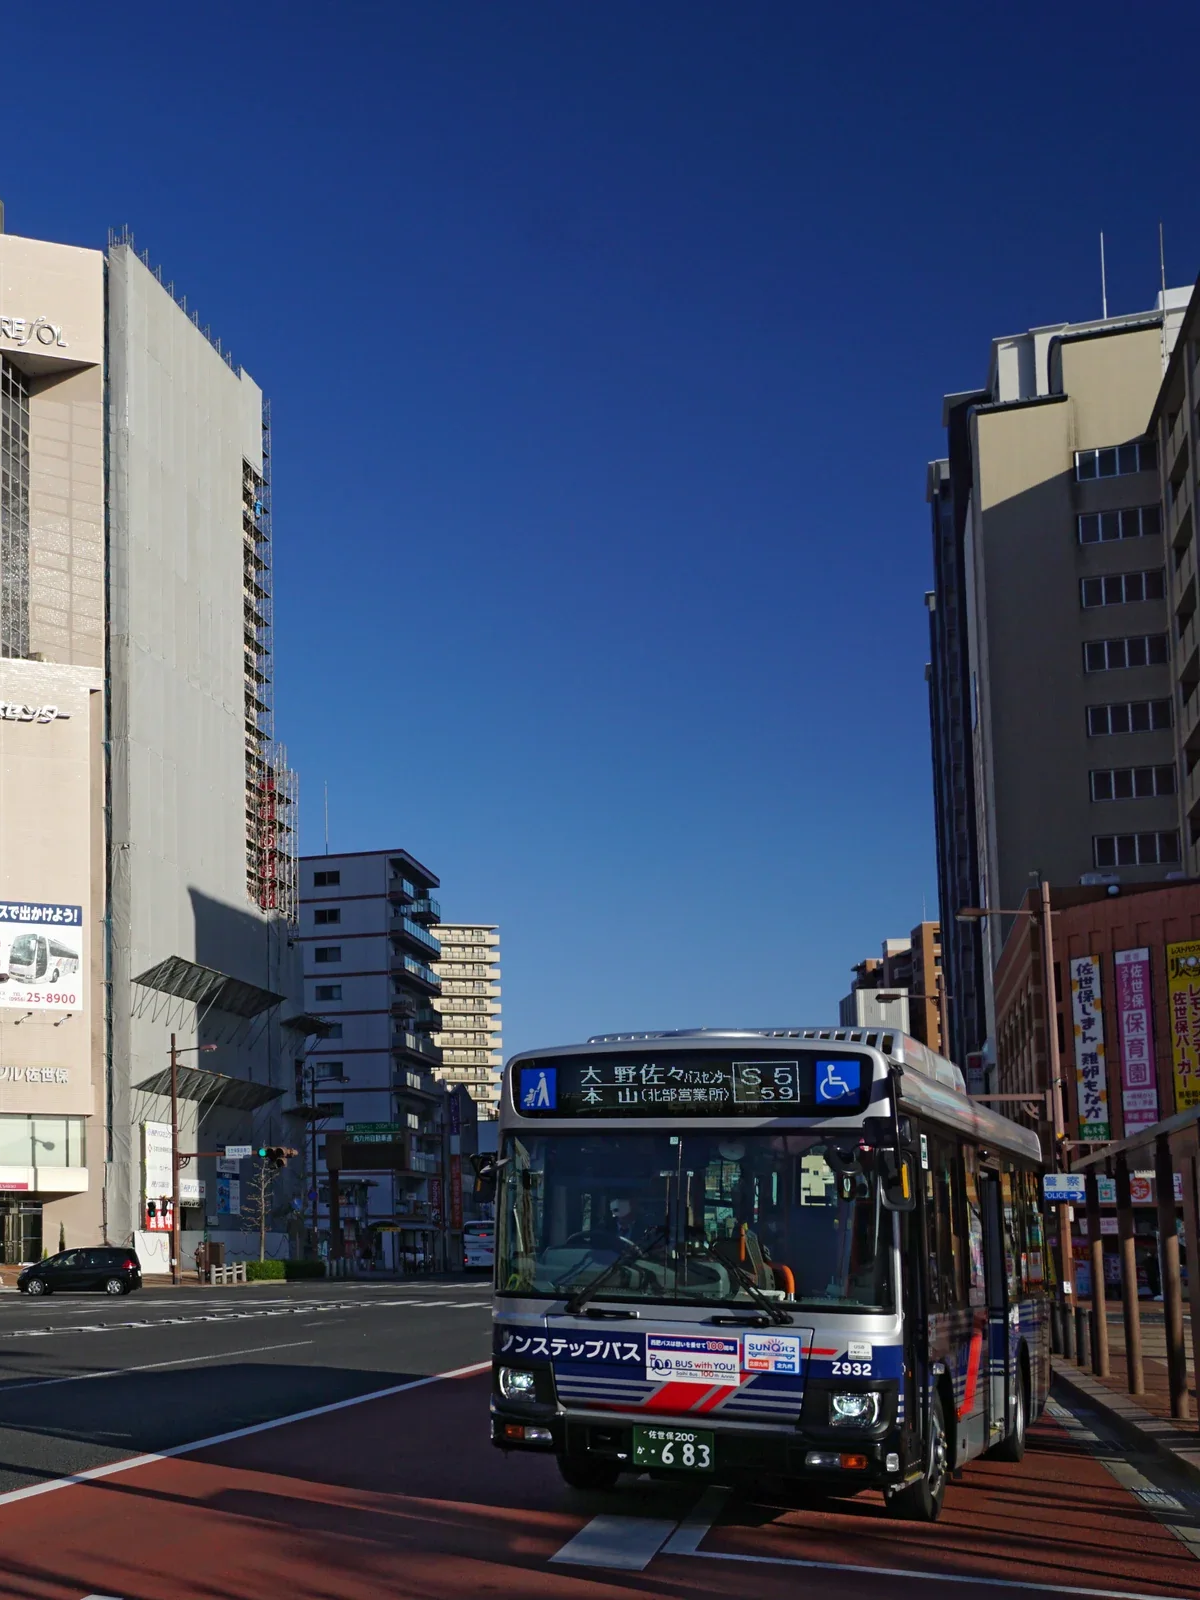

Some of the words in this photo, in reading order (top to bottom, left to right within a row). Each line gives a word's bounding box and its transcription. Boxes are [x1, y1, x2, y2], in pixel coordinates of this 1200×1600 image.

[26, 992, 76, 1004] 25-8900
[1130, 964, 1145, 1008] 佐世保
[1076, 963, 1098, 1044] 佐世保じまん
[1125, 1013, 1147, 1083] 保育園
[1173, 992, 1192, 1088] 佐世保バーガー
[1044, 1176, 1079, 1187] 警察
[500, 1335, 641, 1362] ノンステップバス
[675, 1359, 693, 1368] BUS
[694, 1361, 712, 1370] with
[713, 1362, 736, 1371] YOU!
[831, 1361, 872, 1376] Z932
